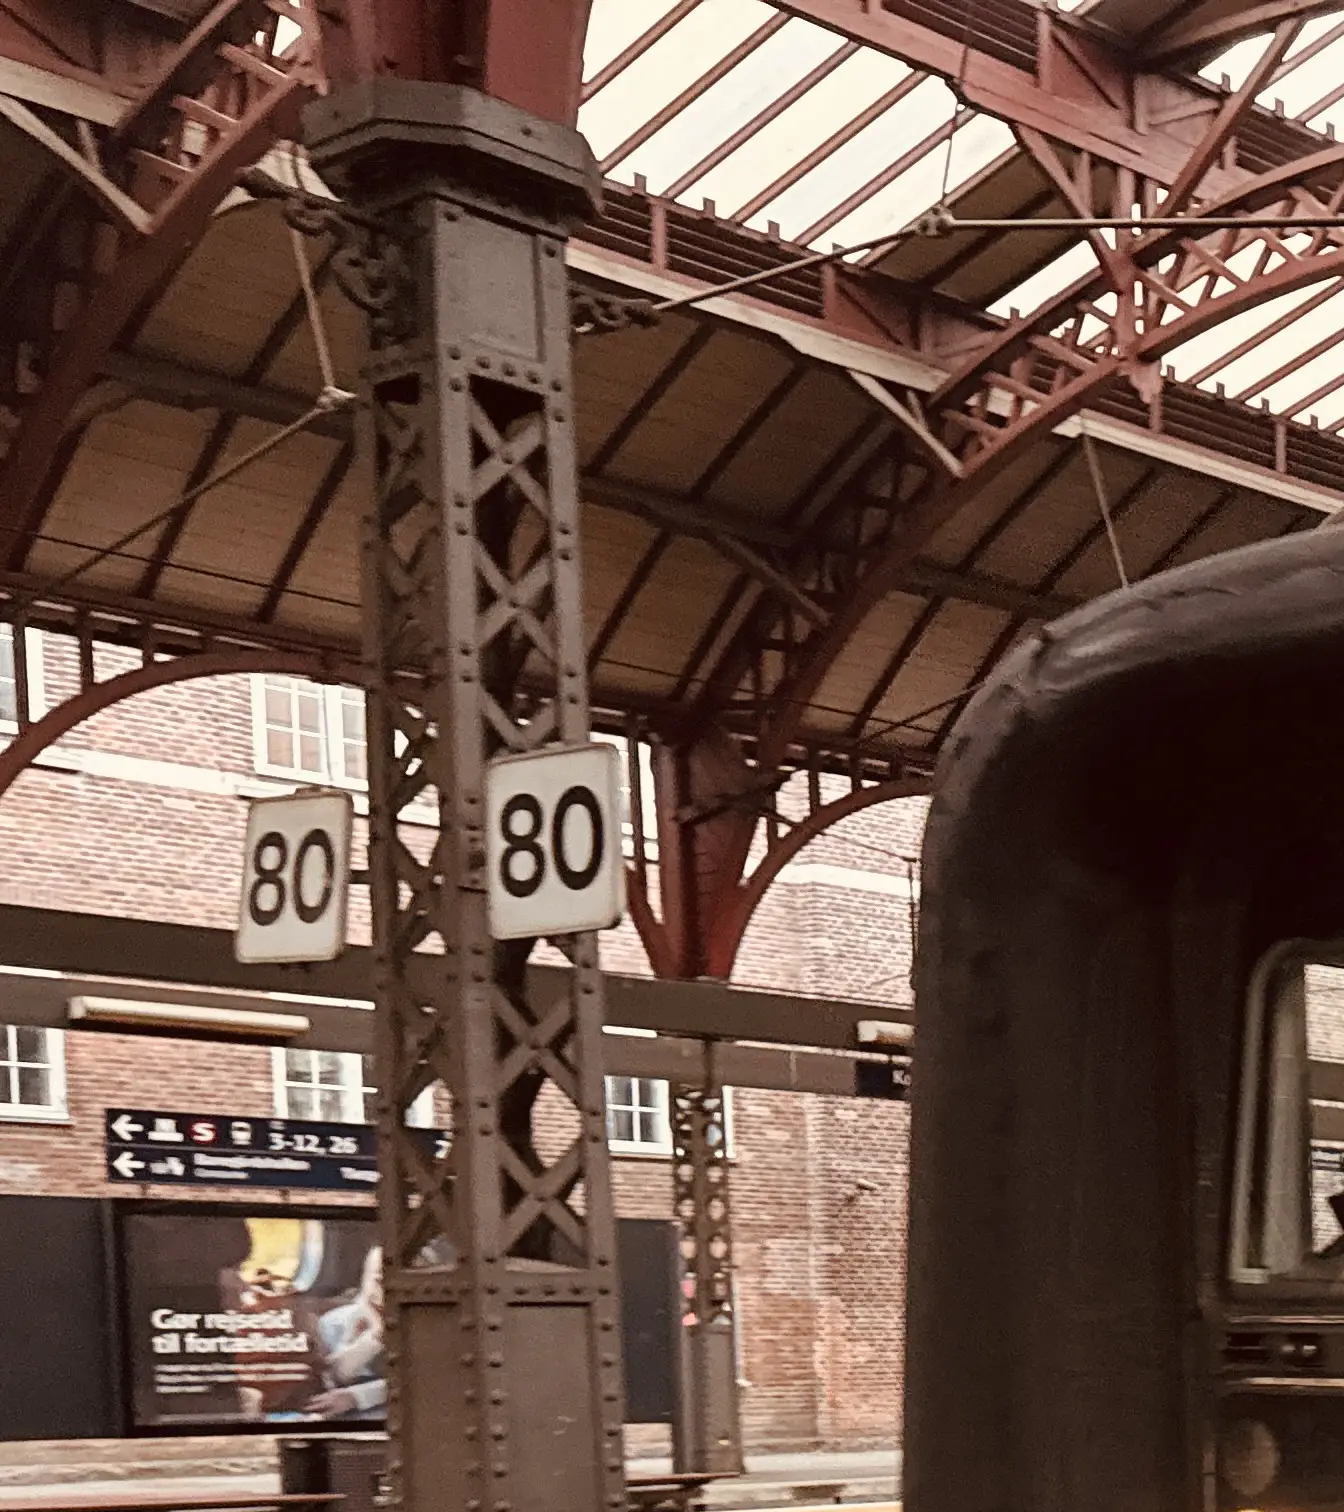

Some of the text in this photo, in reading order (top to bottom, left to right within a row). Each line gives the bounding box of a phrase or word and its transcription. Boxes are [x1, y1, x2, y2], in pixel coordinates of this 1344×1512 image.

[249, 828, 335, 926] 80
[500, 785, 604, 898] 80
[191, 1122, 216, 1142] S
